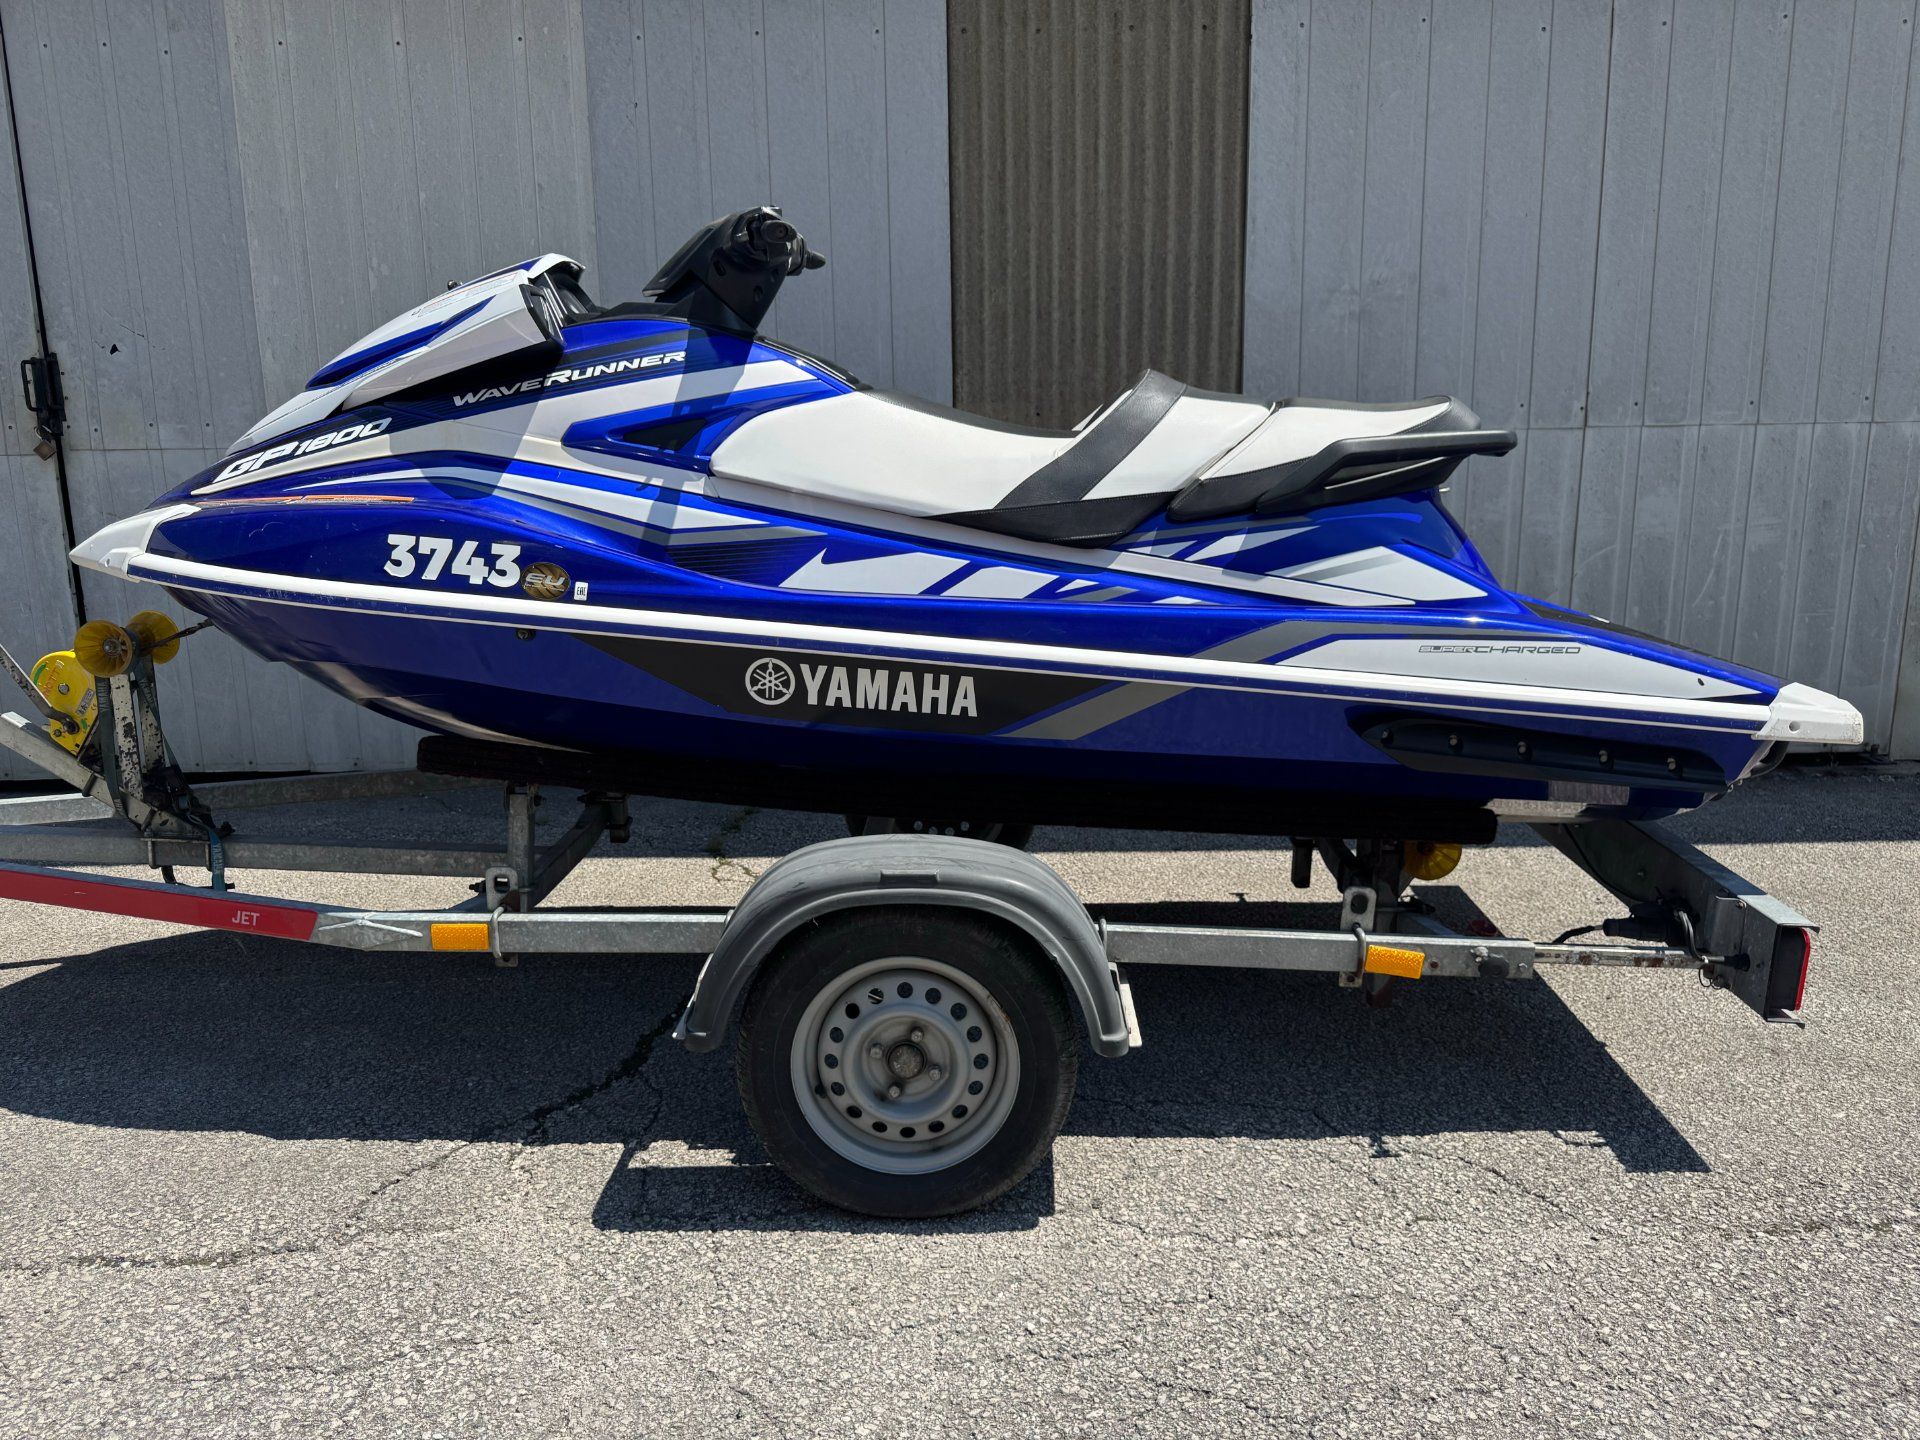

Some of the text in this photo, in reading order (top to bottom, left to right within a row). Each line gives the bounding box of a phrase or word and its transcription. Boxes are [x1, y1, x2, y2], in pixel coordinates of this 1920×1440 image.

[452, 351, 687, 407] WAVERUNNER
[212, 417, 393, 483] GP1800
[383, 533, 521, 588] 3743
[1418, 645, 1581, 654] SUPERCHARGED
[800, 663, 978, 717] YAMAHA
[231, 910, 260, 926] JET
